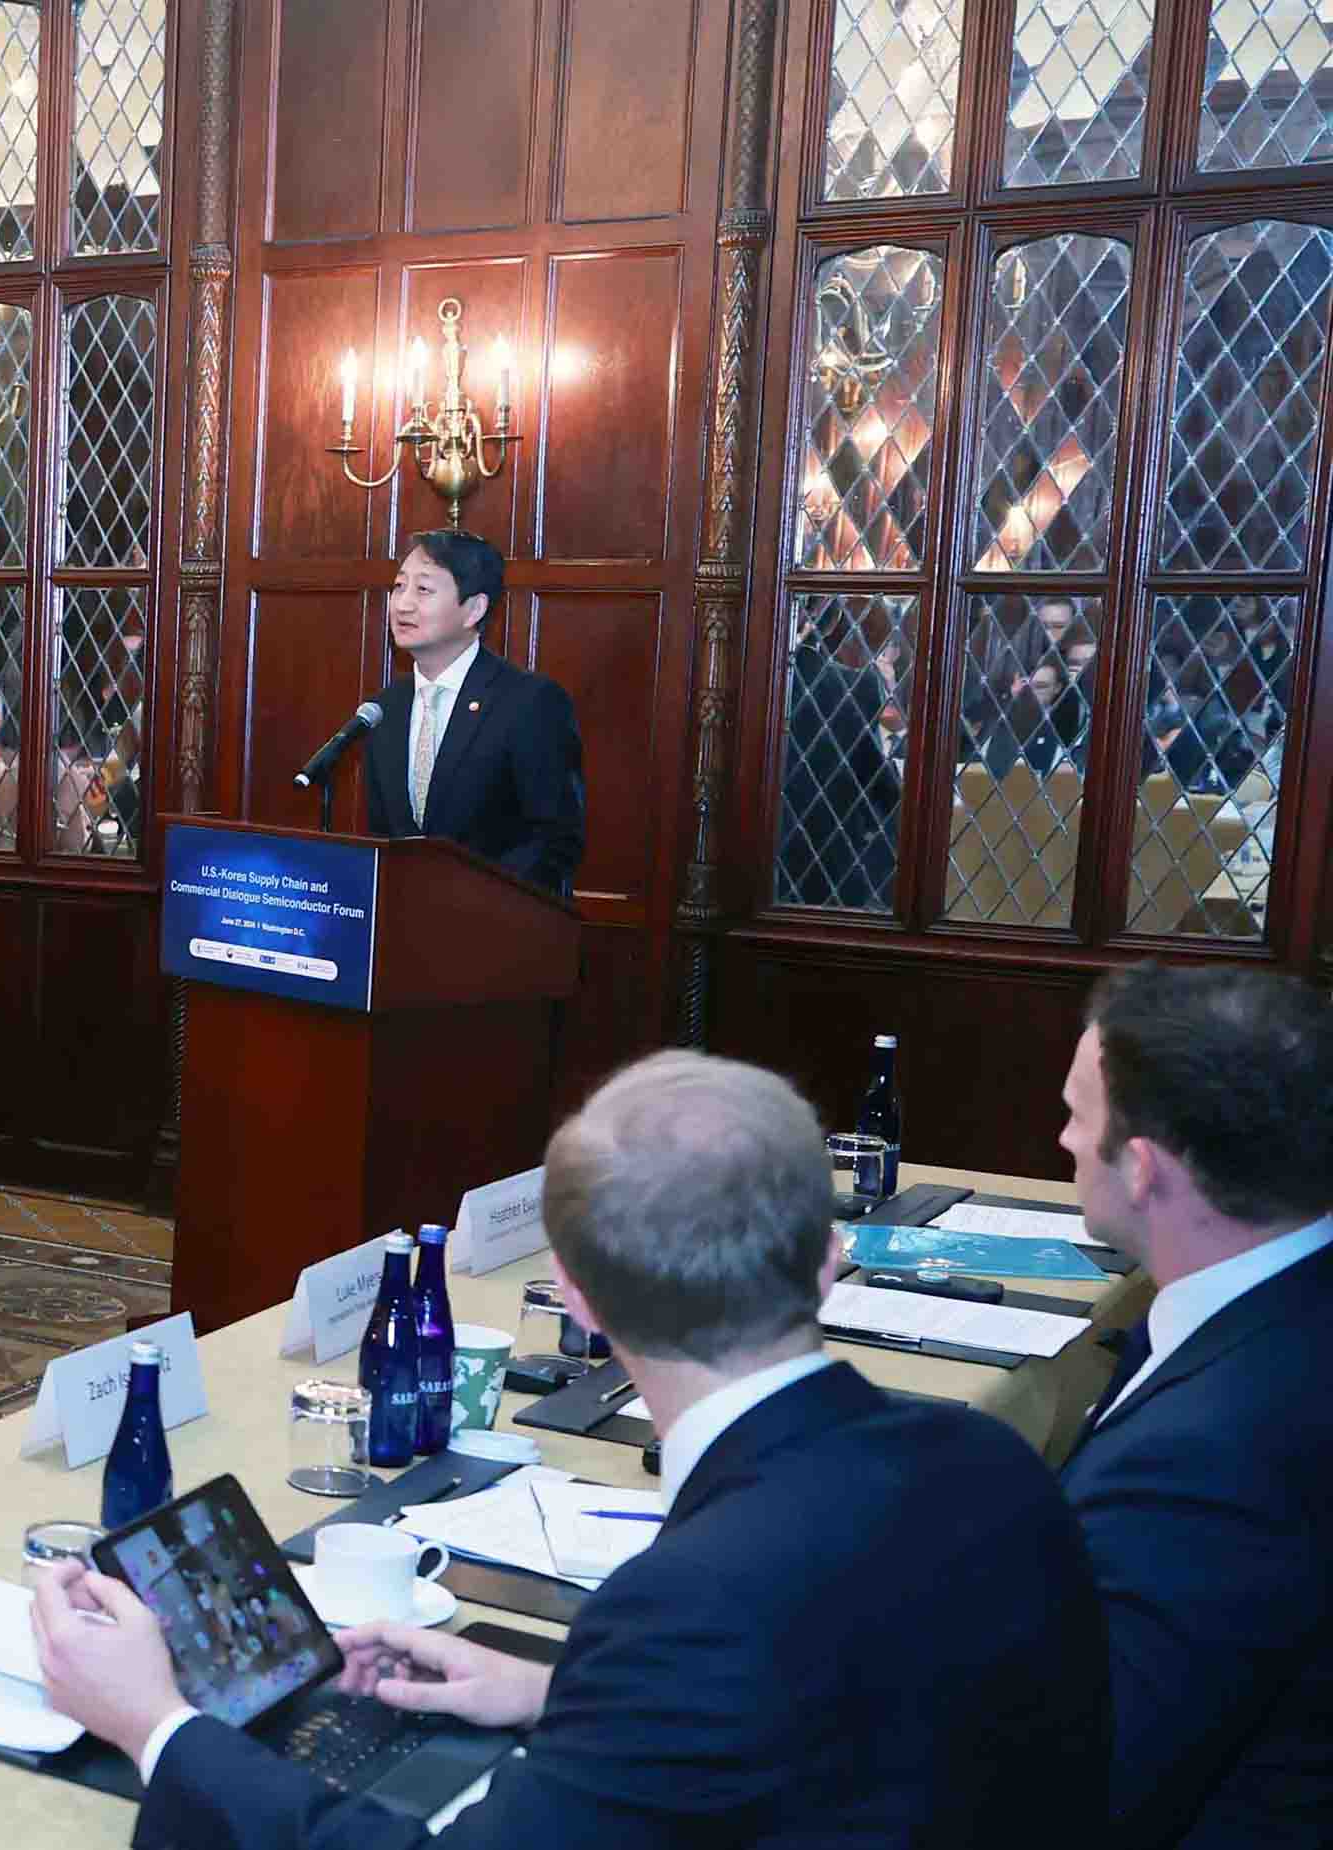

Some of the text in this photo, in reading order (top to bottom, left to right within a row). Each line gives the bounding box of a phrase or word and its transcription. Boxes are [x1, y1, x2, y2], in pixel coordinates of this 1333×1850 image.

[201, 865, 329, 894] U.S.-Korea Supply Chain and
[171, 880, 365, 920] Commercial Dialogue Semiconductor Forum
[87, 1372, 118, 1401] Zach
